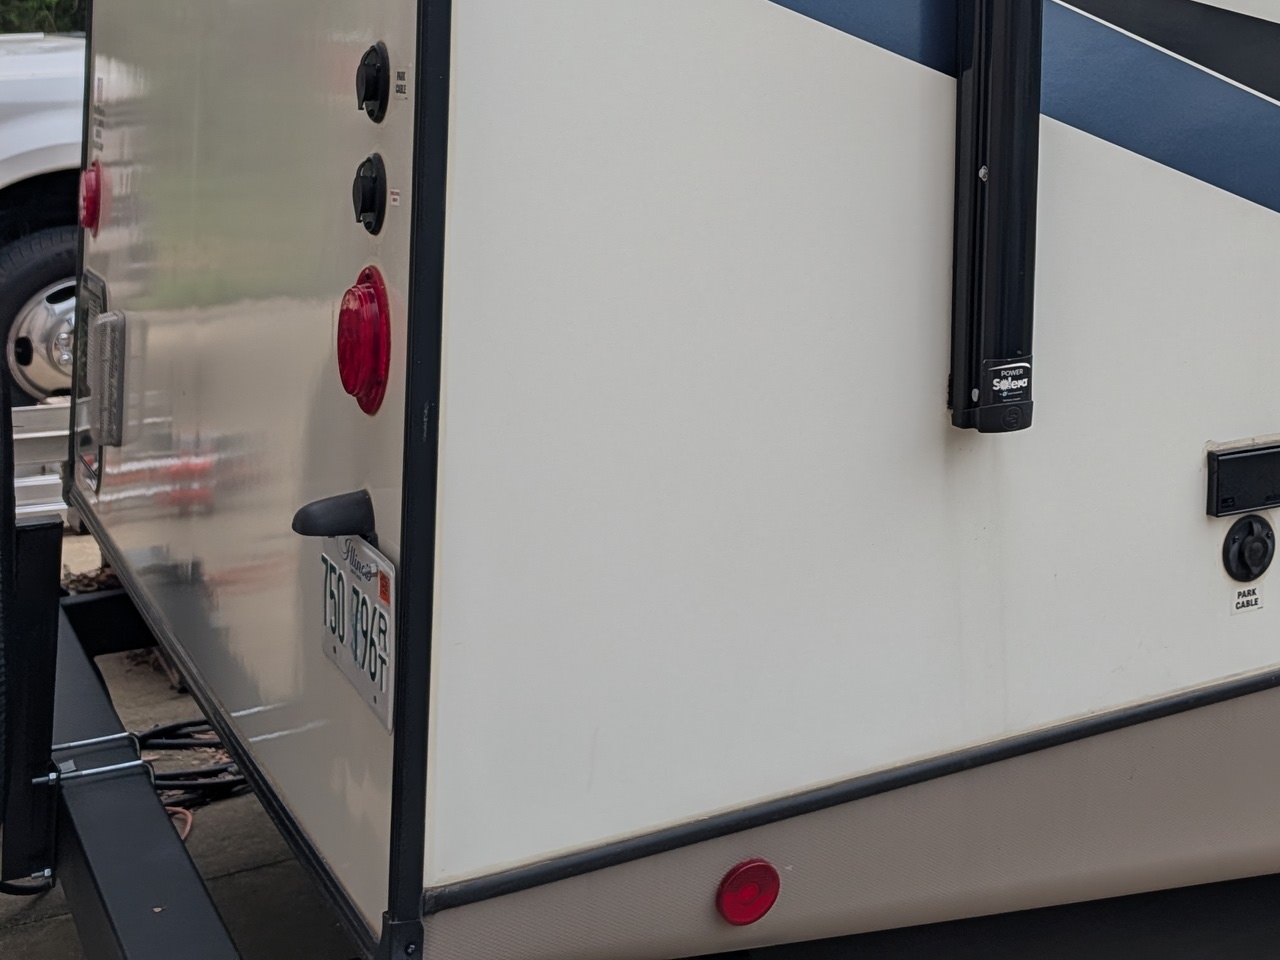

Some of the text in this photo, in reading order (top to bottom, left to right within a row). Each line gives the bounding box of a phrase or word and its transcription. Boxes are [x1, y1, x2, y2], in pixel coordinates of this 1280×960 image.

[1001, 368, 1024, 377] POWER
[992, 376, 1029, 391] Solera
[1237, 588, 1257, 600] PARK
[1235, 598, 1259, 610] CABLE
[321, 552, 346, 645] 750
[352, 585, 377, 682] 796
